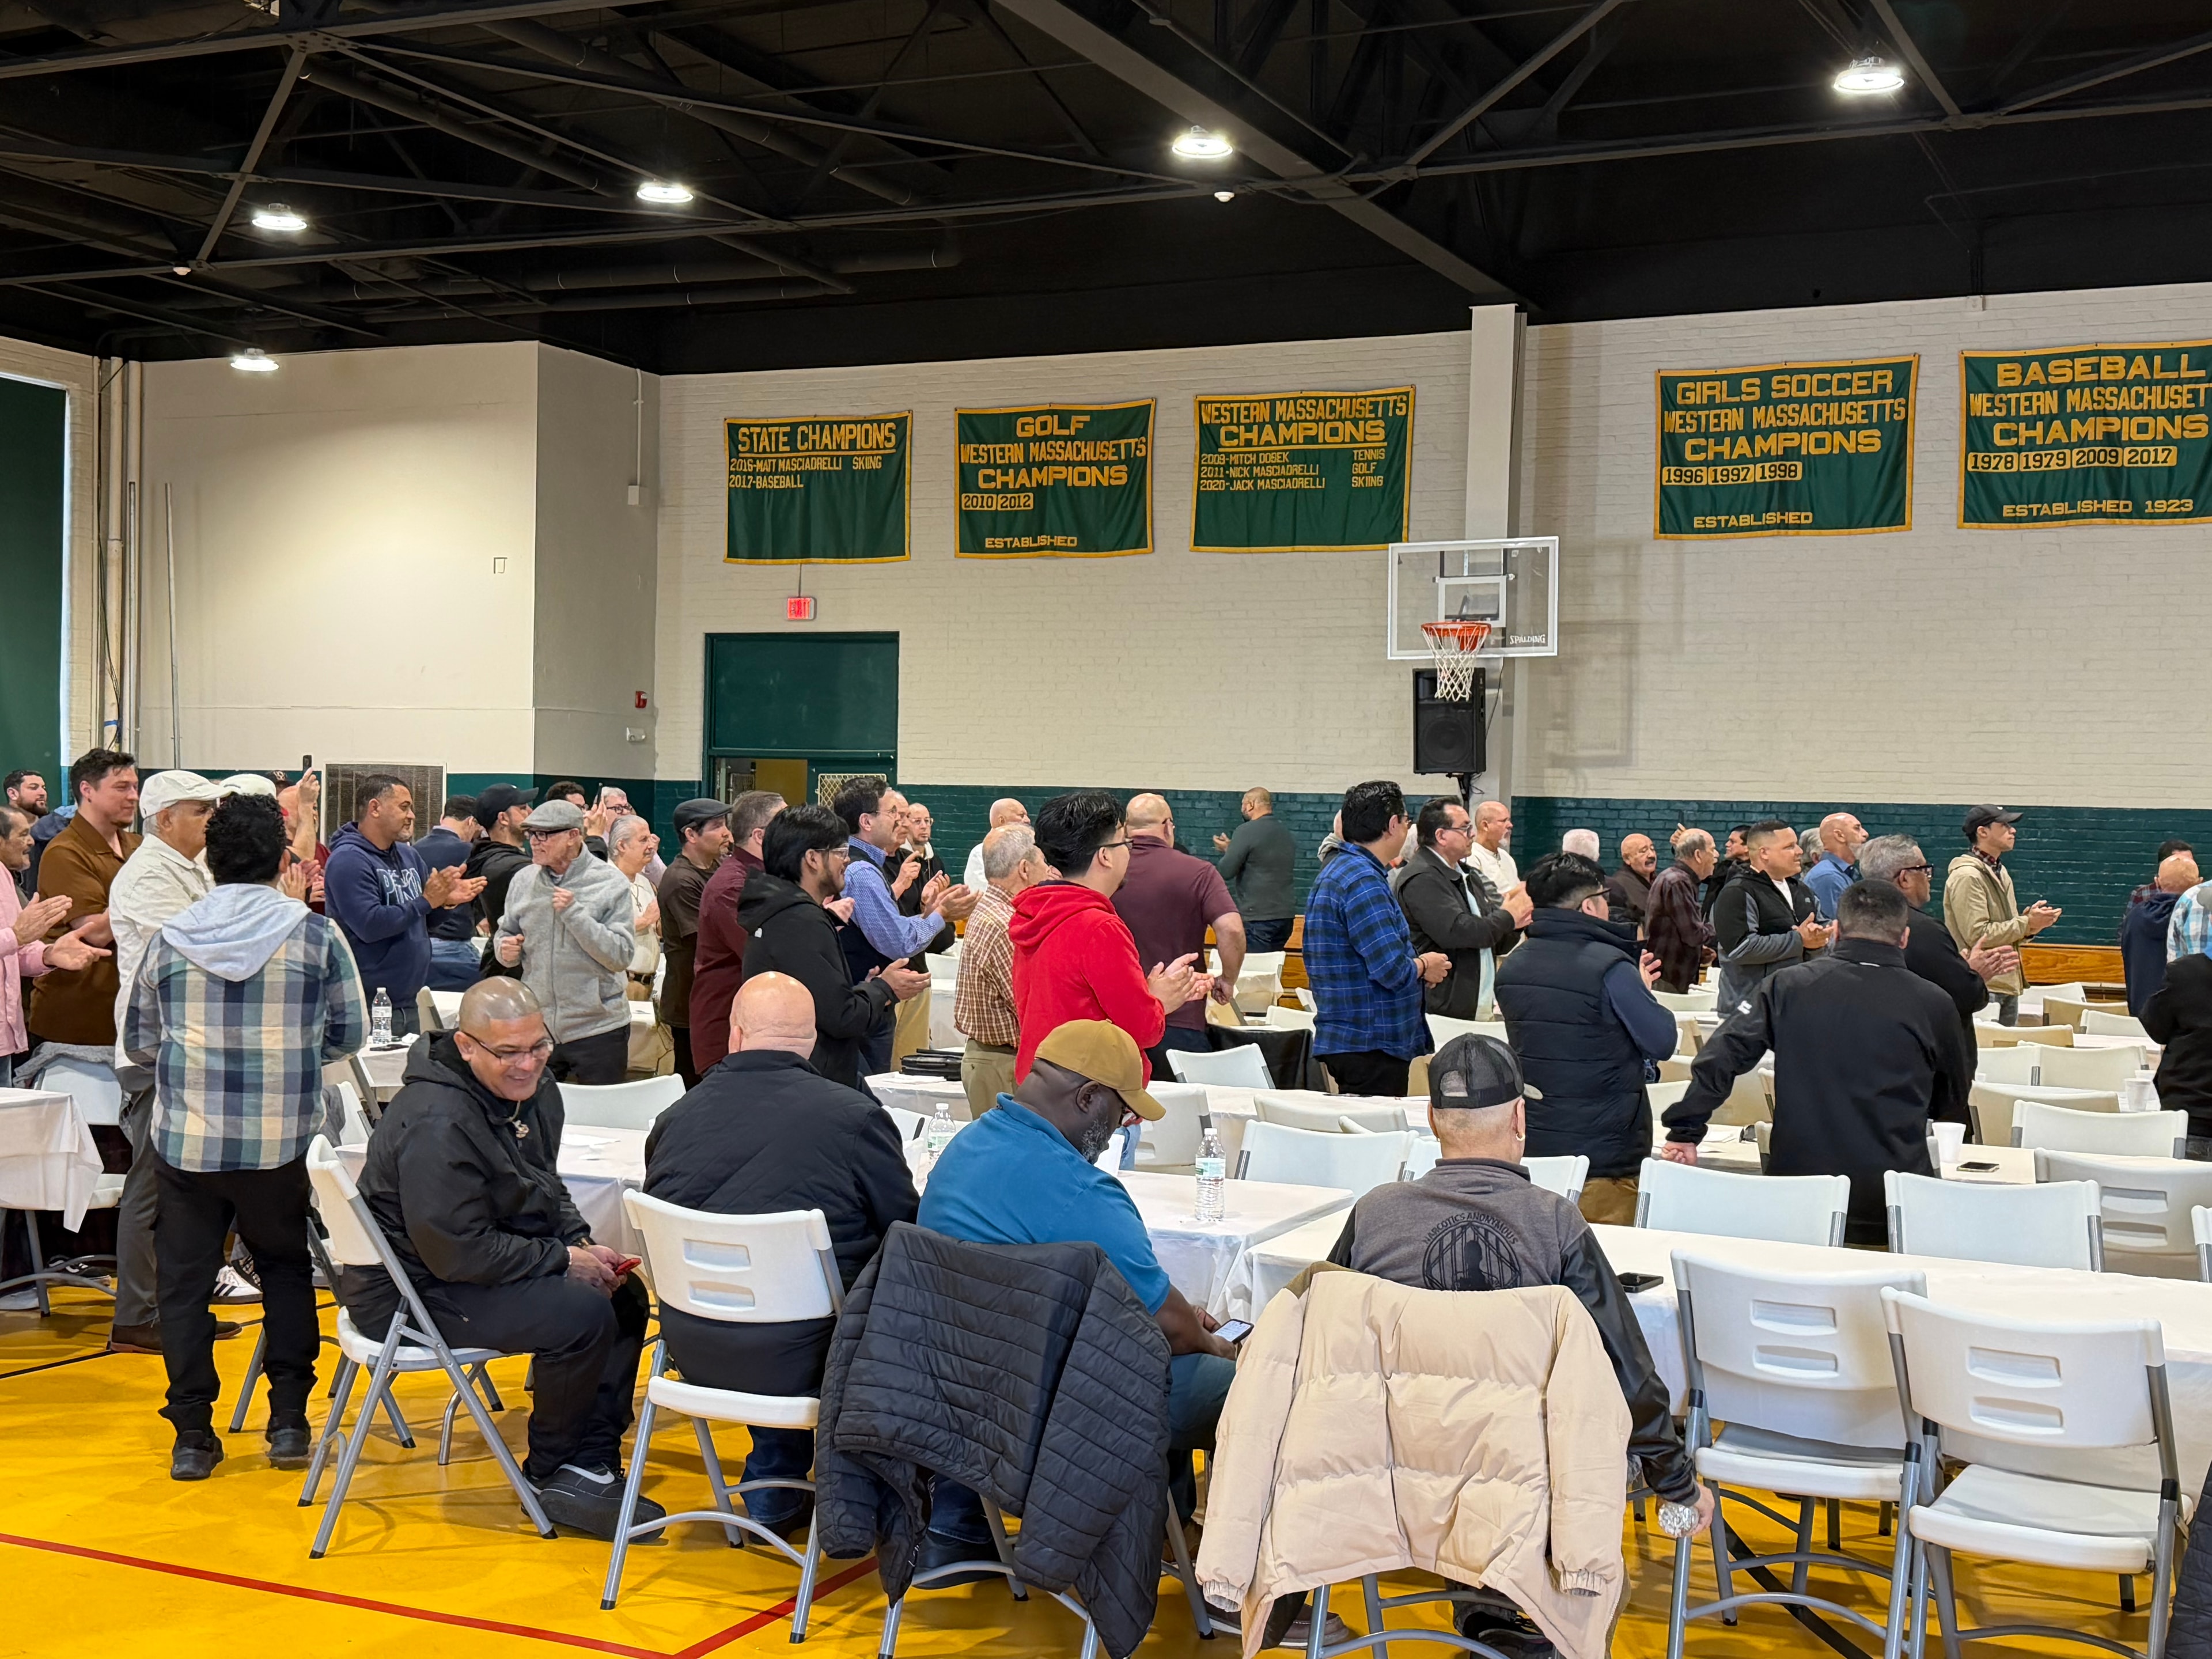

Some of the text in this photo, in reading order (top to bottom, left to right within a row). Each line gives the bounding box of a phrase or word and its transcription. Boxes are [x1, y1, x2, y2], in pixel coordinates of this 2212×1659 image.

[1997, 354, 2206, 387] BASEBALL
[1677, 370, 1893, 404] GIRLS SOCCER
[1201, 395, 1407, 424] WESTERN MASSACHUSETTS
[1969, 390, 2058, 417] WESTERN
[1016, 415, 1090, 437] GOLF
[1664, 397, 1906, 433] WESTERN MASSACHUSETTS
[738, 422, 896, 452] STATE CHAMPIONS
[1220, 420, 1385, 446] CHAMPIONS
[1993, 414, 2209, 446] CHAMPIONS
[960, 437, 1146, 464] WESTERN MASSACHUSETTS
[1353, 448, 1385, 461] TENNIS
[1684, 429, 1881, 461] CHAMPIONS
[730, 457, 777, 472] 2016-MATT
[852, 456, 882, 470] SKIING
[1352, 461, 1377, 474] GOLF
[1971, 448, 2173, 470] 1978 1979 2009 2017
[729, 474, 804, 489] 2017-BASEBALL
[978, 465, 1128, 489] CHAMPIONS
[1200, 479, 1255, 491] 2020-JACK
[1351, 475, 1384, 487] SKIING
[1665, 463, 1798, 483] 1996 1997 1998
[964, 495, 1031, 509] 2010 2012
[2002, 499, 2194, 517] ESTABLISHED 1923
[1694, 512, 1813, 529] ESTABLISHED
[985, 535, 1077, 549] ESTABLISHED
[1509, 634, 1546, 645] SPALDING
[1423, 1212, 1519, 1245] NARCOTICS ANONYMOUS
